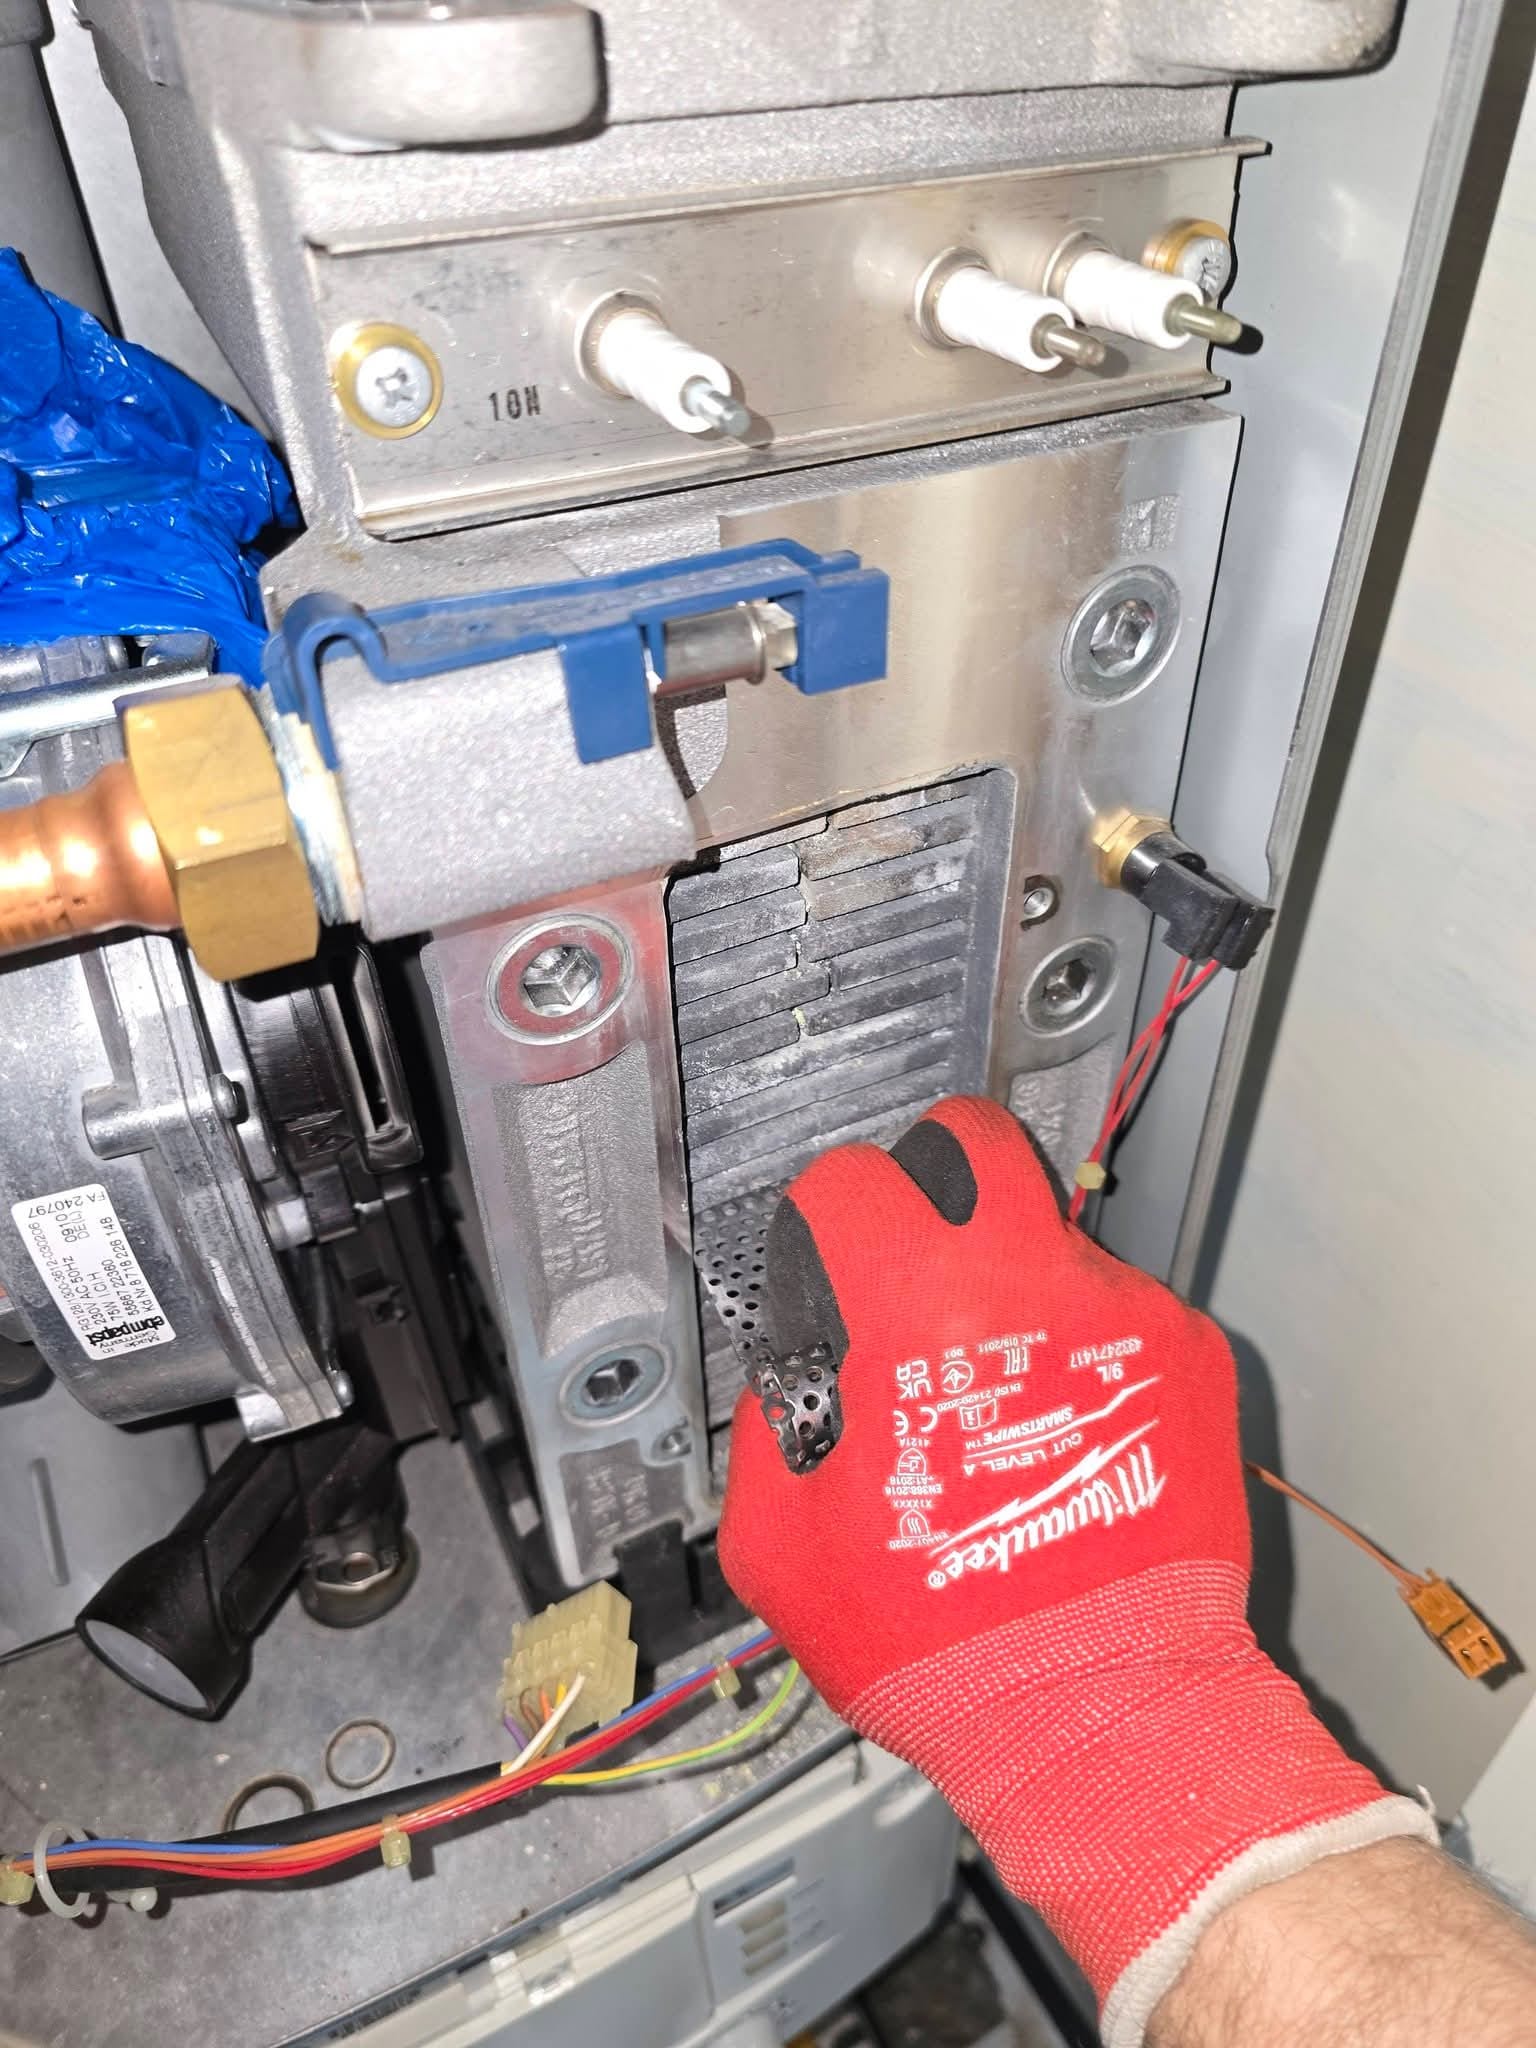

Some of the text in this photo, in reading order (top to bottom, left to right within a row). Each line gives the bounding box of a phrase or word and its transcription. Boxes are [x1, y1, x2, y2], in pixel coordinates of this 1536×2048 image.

[28, 1195, 83, 1219] 240797
[55, 1213, 78, 1243] 0910
[100, 1216, 118, 1236] 148
[110, 1239, 129, 1259] 226
[62, 1256, 107, 1326] 230V AC 50Hz
[101, 1301, 123, 1321] 75W
[85, 1315, 165, 1346] ebmpapst
[896, 1359, 929, 1381] CA
[1096, 1362, 1124, 1383] 9/L
[898, 1378, 932, 1400] UK
[963, 1430, 1082, 1477] CUT LEVEL A
